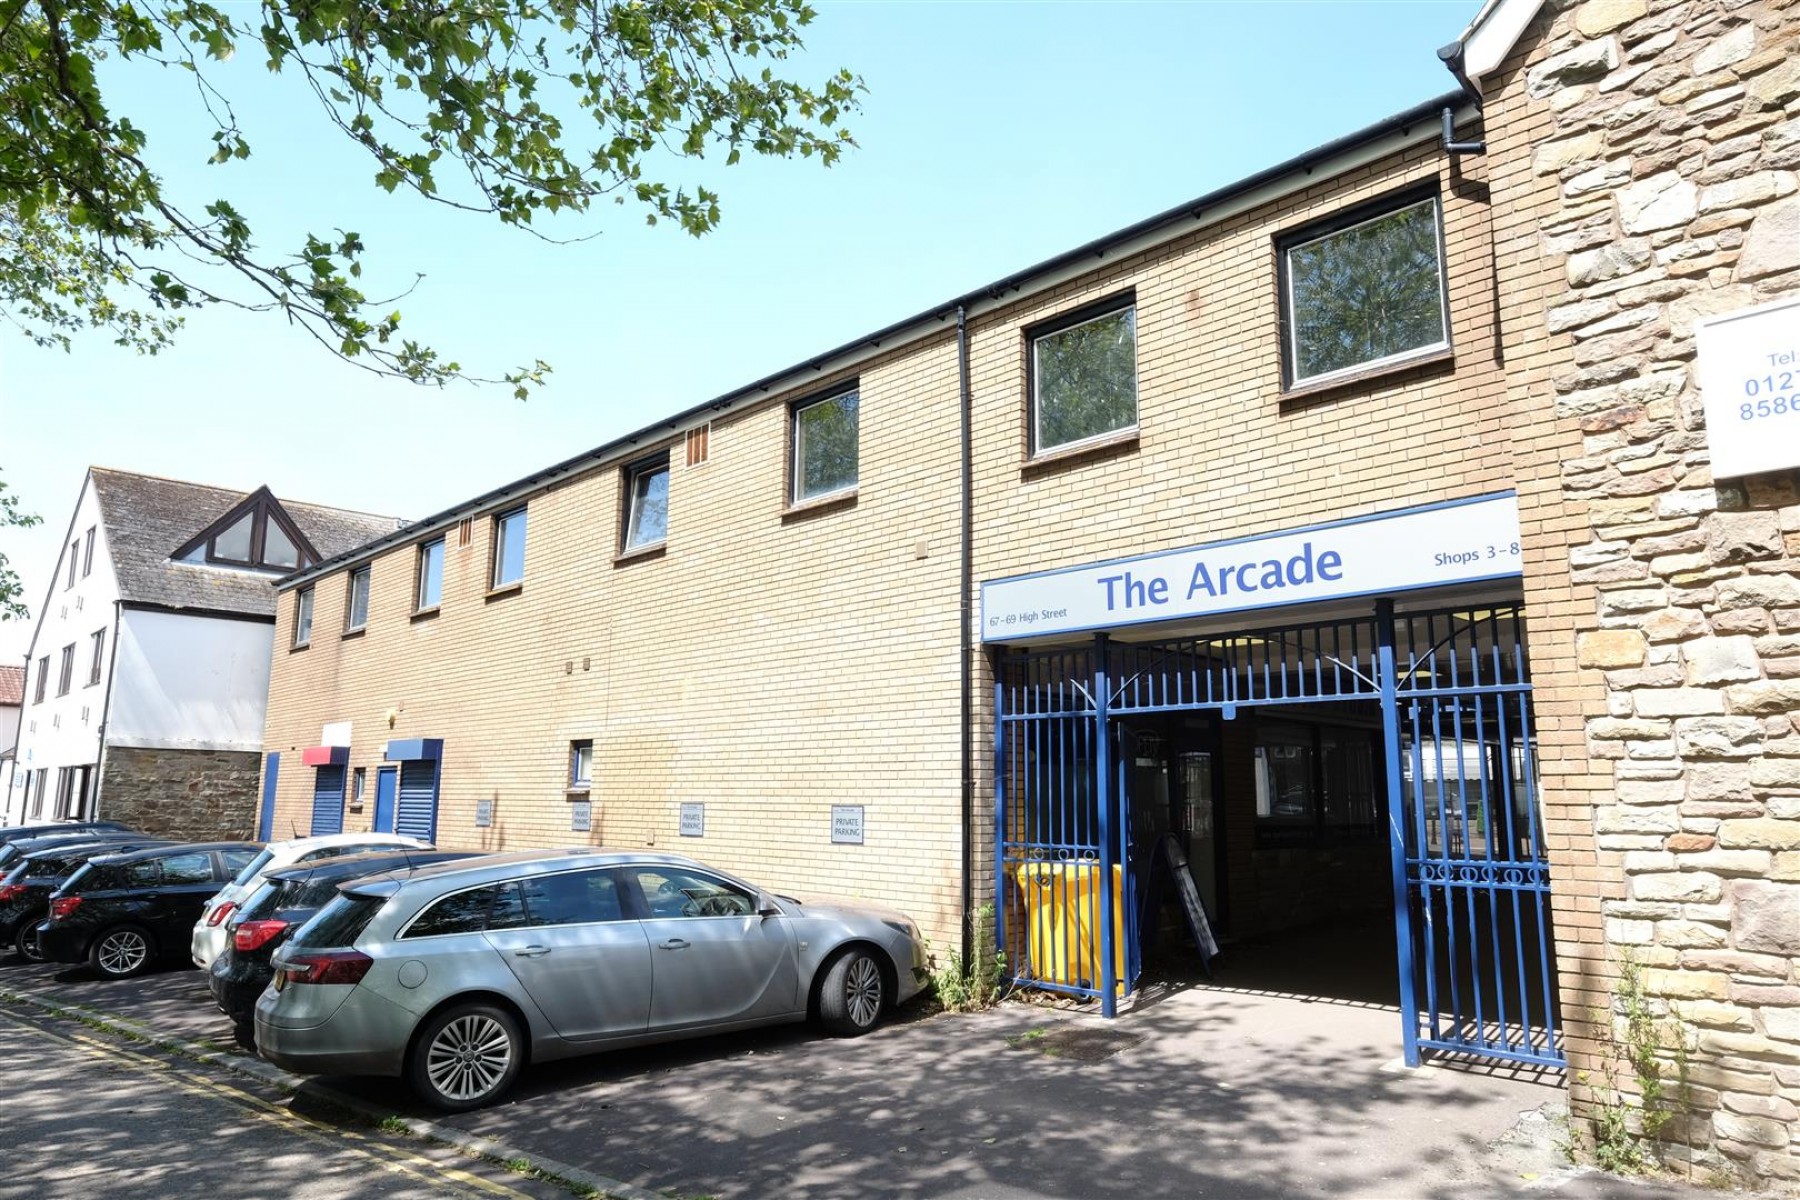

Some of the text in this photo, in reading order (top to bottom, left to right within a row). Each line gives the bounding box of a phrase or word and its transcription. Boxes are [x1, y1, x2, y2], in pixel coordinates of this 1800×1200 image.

[1744, 370, 1800, 396] 012
[1740, 393, 1800, 421] 8586
[1434, 550, 1480, 567] Shops
[1098, 542, 1343, 611] The Arcade
[1019, 610, 1039, 624] High
[1041, 608, 1067, 620] Street
[835, 817, 860, 827] PRIVATE
[834, 827, 860, 837] PARKING
